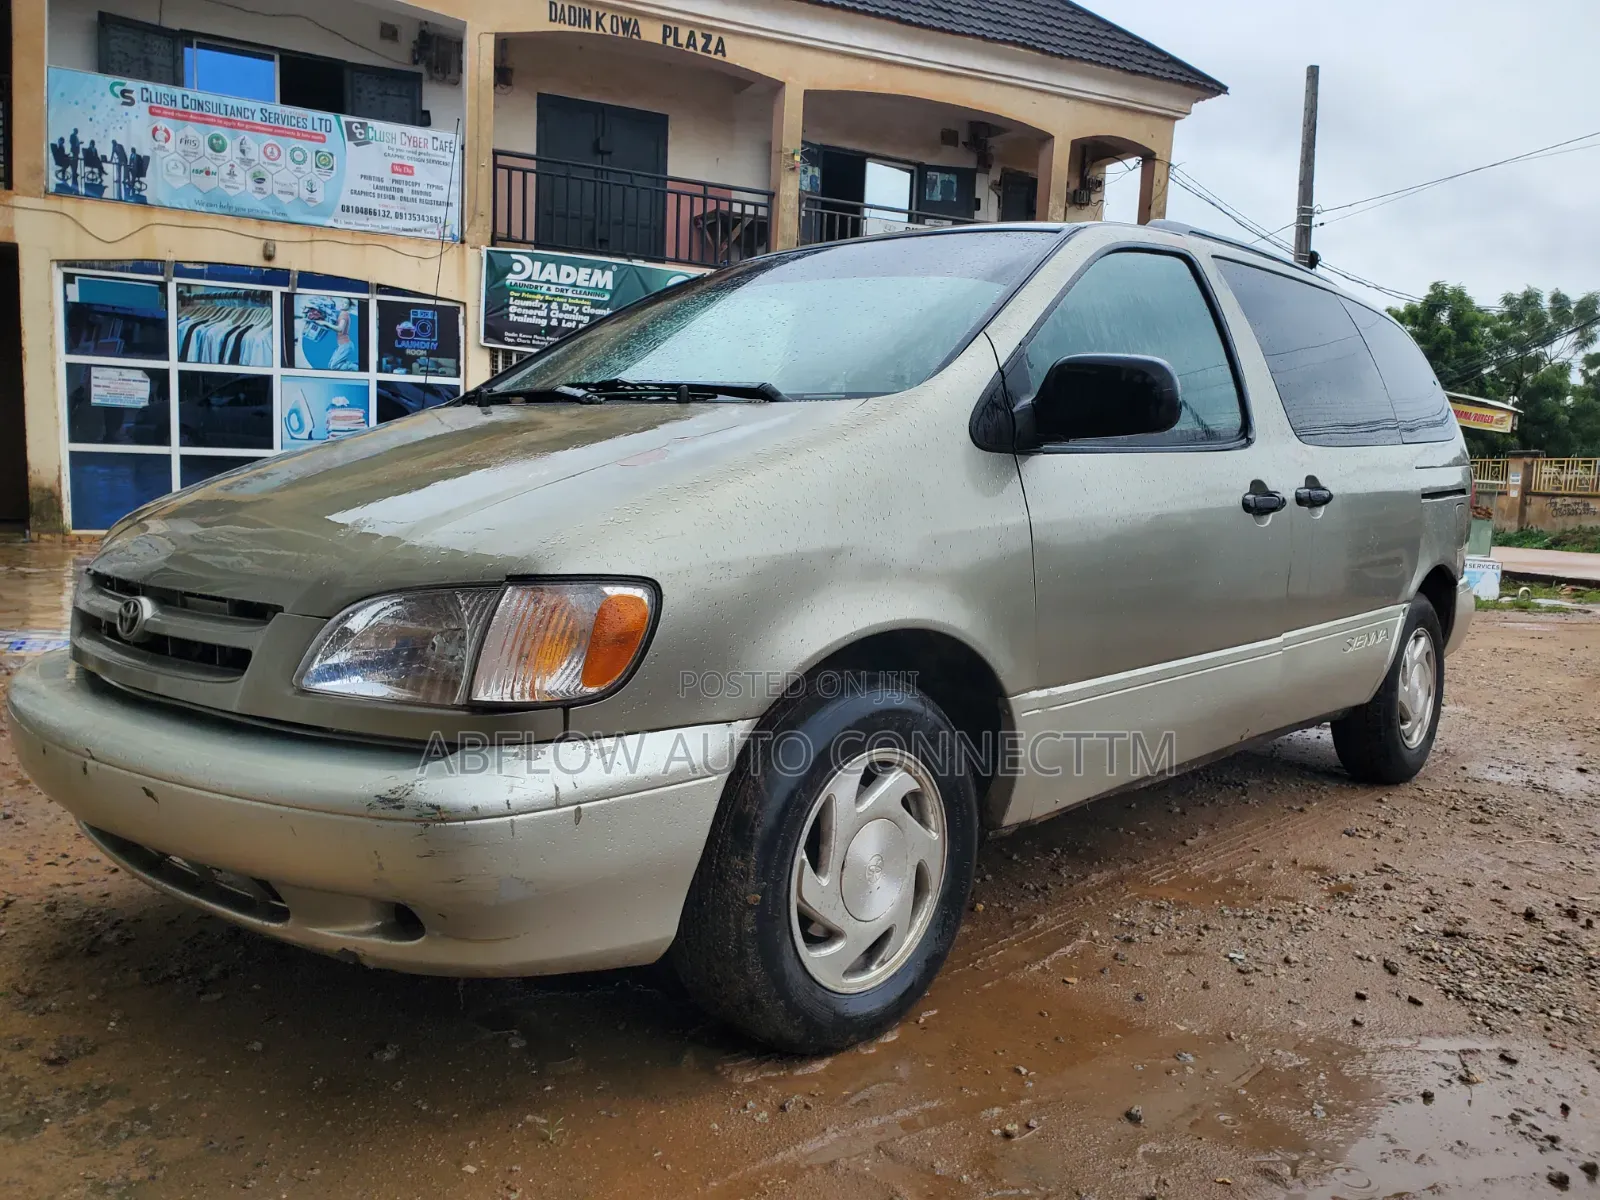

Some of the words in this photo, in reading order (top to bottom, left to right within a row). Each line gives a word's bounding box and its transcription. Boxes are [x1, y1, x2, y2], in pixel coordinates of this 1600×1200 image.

[595, 12, 642, 40] KOWA
[662, 24, 727, 58] PLAZA
[141, 87, 177, 108] CLUSH
[182, 94, 257, 121] CONSULTANCY
[260, 107, 308, 130] SERVICES
[312, 116, 332, 133] LTD
[367, 126, 397, 145] CLUSH
[400, 131, 429, 150] CYBER
[432, 136, 455, 154] CAFÉ
[360, 174, 385, 183] PRINTING
[392, 178, 421, 188] PHOTOCOPY
[427, 183, 444, 191] TYPING
[373, 184, 404, 194] LAMINATION
[411, 189, 432, 198] BINDING
[350, 189, 376, 198] GRAPHICS
[377, 193, 396, 201] DESIGN
[400, 195, 418, 204] ONLINE
[506, 254, 613, 290] DIADEM
[509, 281, 544, 292] LAUNDRY
[555, 286, 570, 295] DRY
[571, 288, 606, 299] CLEANING
[521, 292, 544, 301] Friendly
[545, 295, 568, 303] Services
[509, 297, 549, 309] Laundry
[550, 301, 559, 310] &
[562, 303, 579, 314] Dry
[508, 306, 548, 317] General
[550, 310, 590, 323] Cleaning
[508, 313, 548, 327] Training
[550, 319, 559, 327] &
[1468, 563, 1500, 571] SERVICES
[1342, 628, 1389, 653] SIENNA
